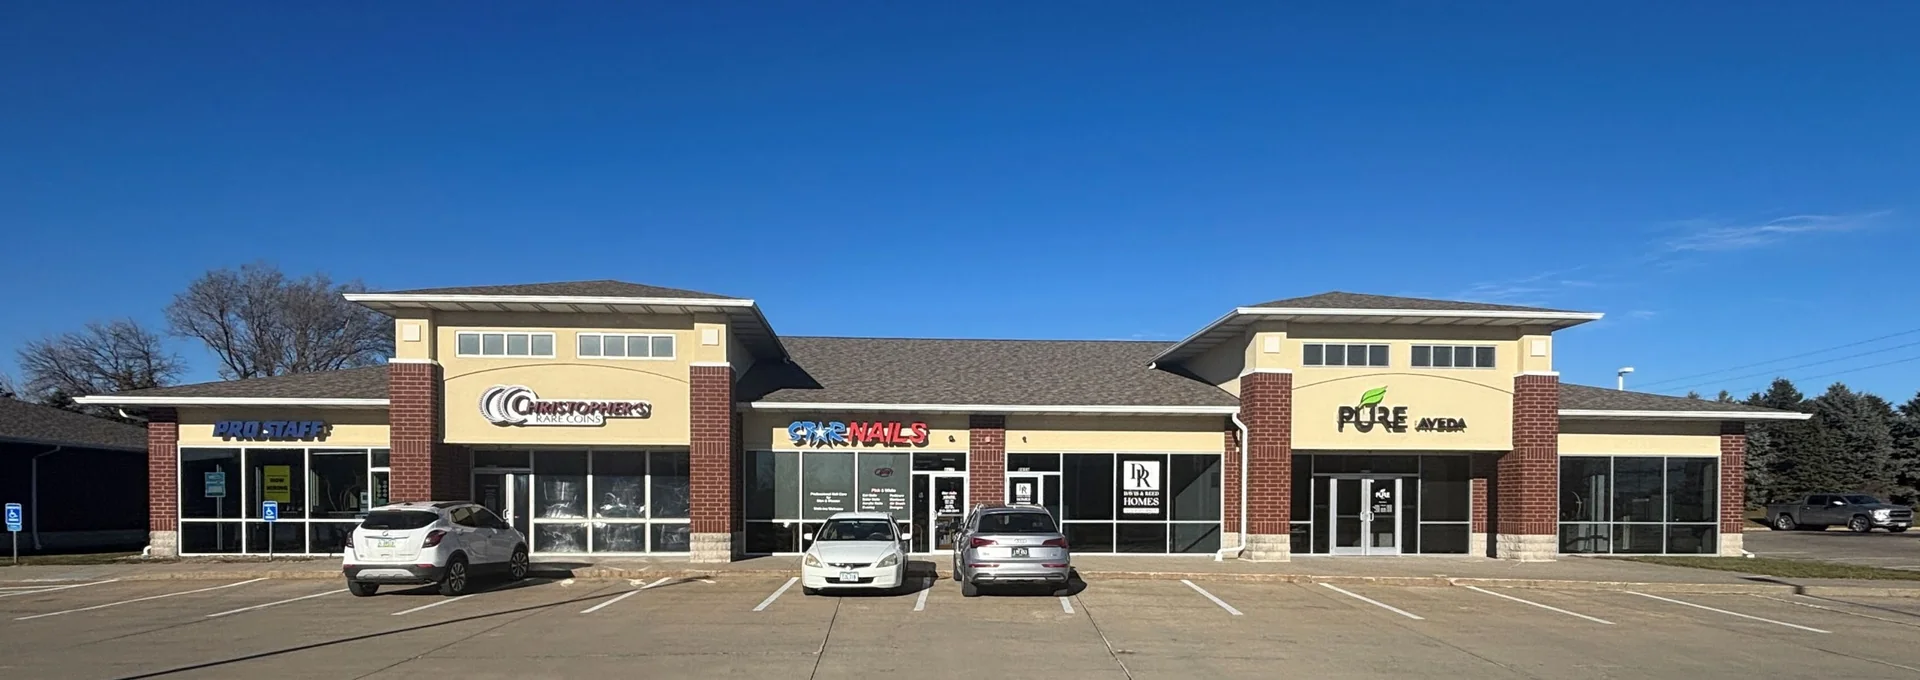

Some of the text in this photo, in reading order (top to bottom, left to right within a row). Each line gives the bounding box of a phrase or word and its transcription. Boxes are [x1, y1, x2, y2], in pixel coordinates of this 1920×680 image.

[511, 395, 651, 416] CHRISTOPHER'S
[536, 415, 601, 423] RARE COINS
[1337, 404, 1408, 432] PURE
[1415, 418, 1468, 431] AVEDA
[213, 421, 324, 438] PRO STAFF
[847, 421, 928, 444] NAILS
[1123, 497, 1160, 506] HOMES
